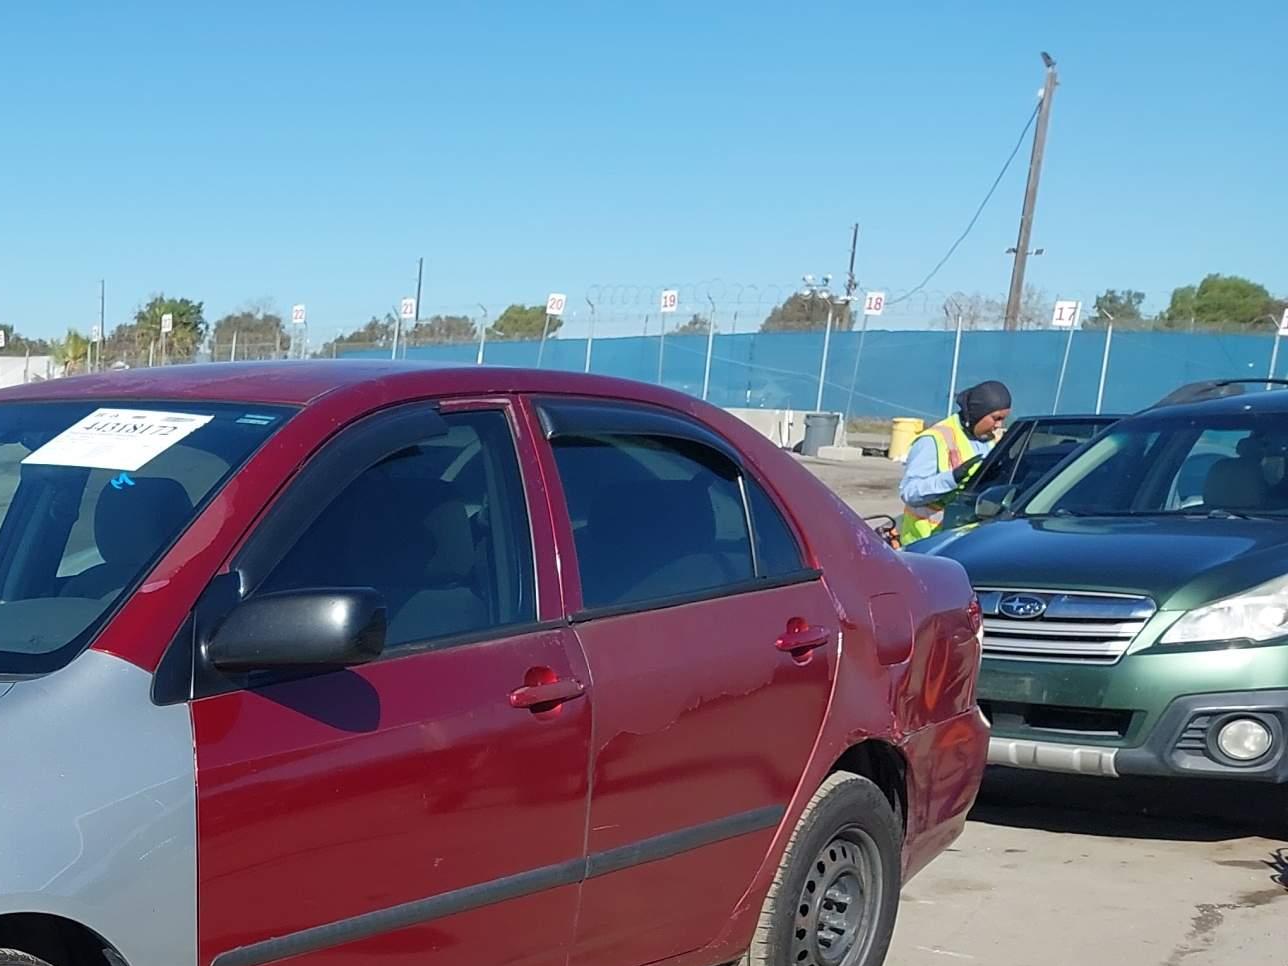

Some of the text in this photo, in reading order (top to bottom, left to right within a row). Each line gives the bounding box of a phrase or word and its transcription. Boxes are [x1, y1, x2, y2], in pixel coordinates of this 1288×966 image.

[549, 297, 563, 310] 20
[663, 295, 676, 308] 19
[866, 296, 883, 311] 18
[294, 309, 305, 320] 22
[403, 303, 414, 315] 21
[1055, 306, 1079, 321] 17
